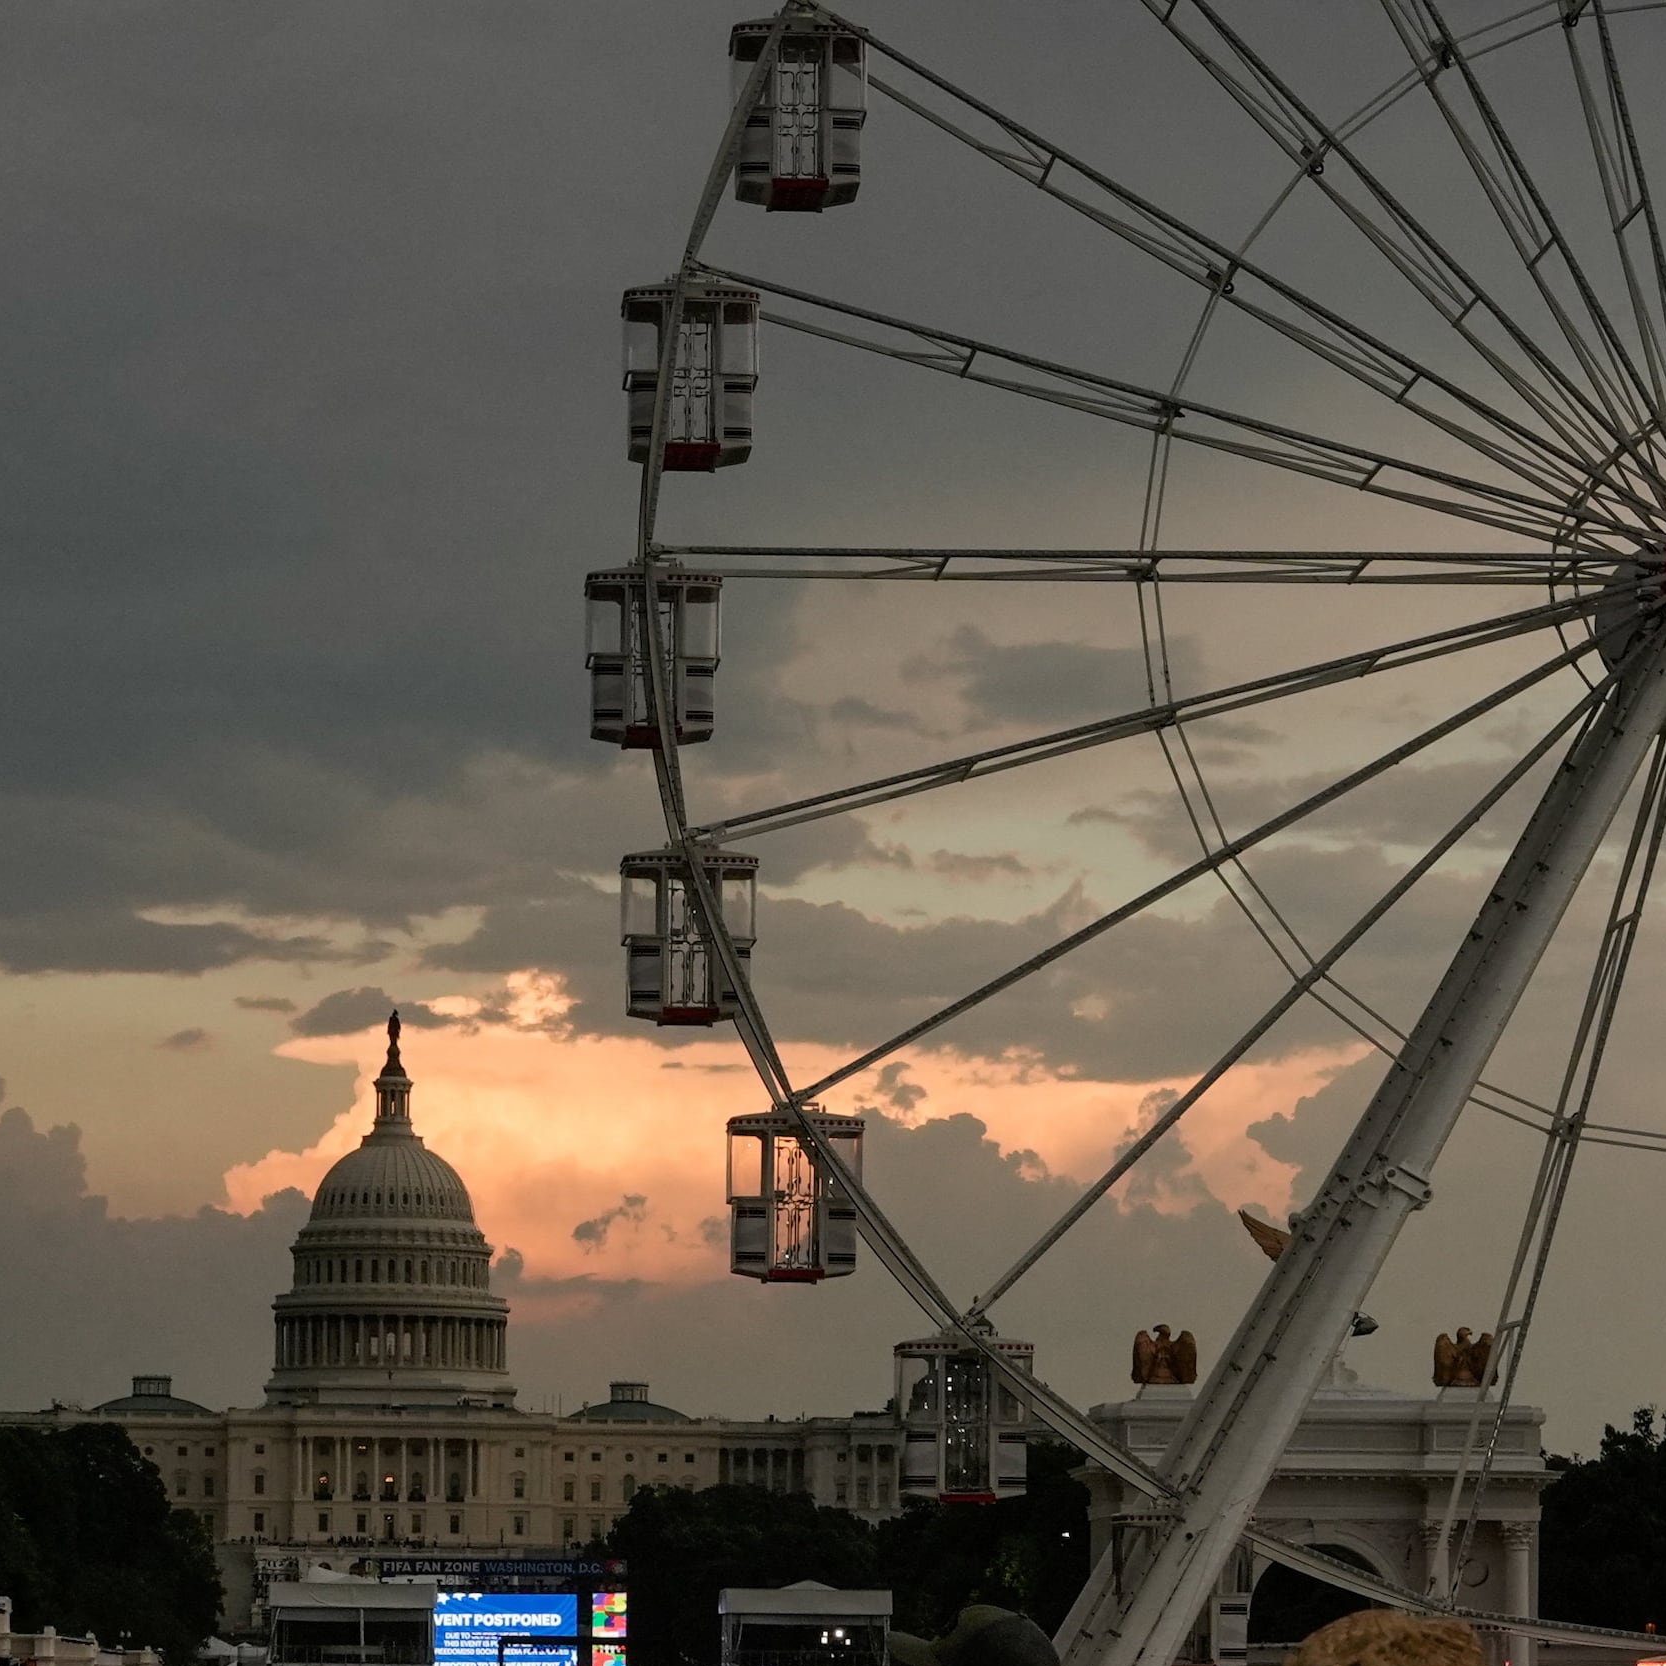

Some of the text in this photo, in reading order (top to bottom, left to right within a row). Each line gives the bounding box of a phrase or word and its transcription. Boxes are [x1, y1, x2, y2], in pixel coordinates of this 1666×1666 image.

[383, 1561, 413, 1573] FIFA
[415, 1561, 441, 1573] FAN
[444, 1561, 480, 1573] ZONE
[579, 1563, 604, 1574] D.C.
[433, 1613, 562, 1627] VENT POSTPONED
[445, 1631, 460, 1640] DUE
[460, 1631, 471, 1640] TO
